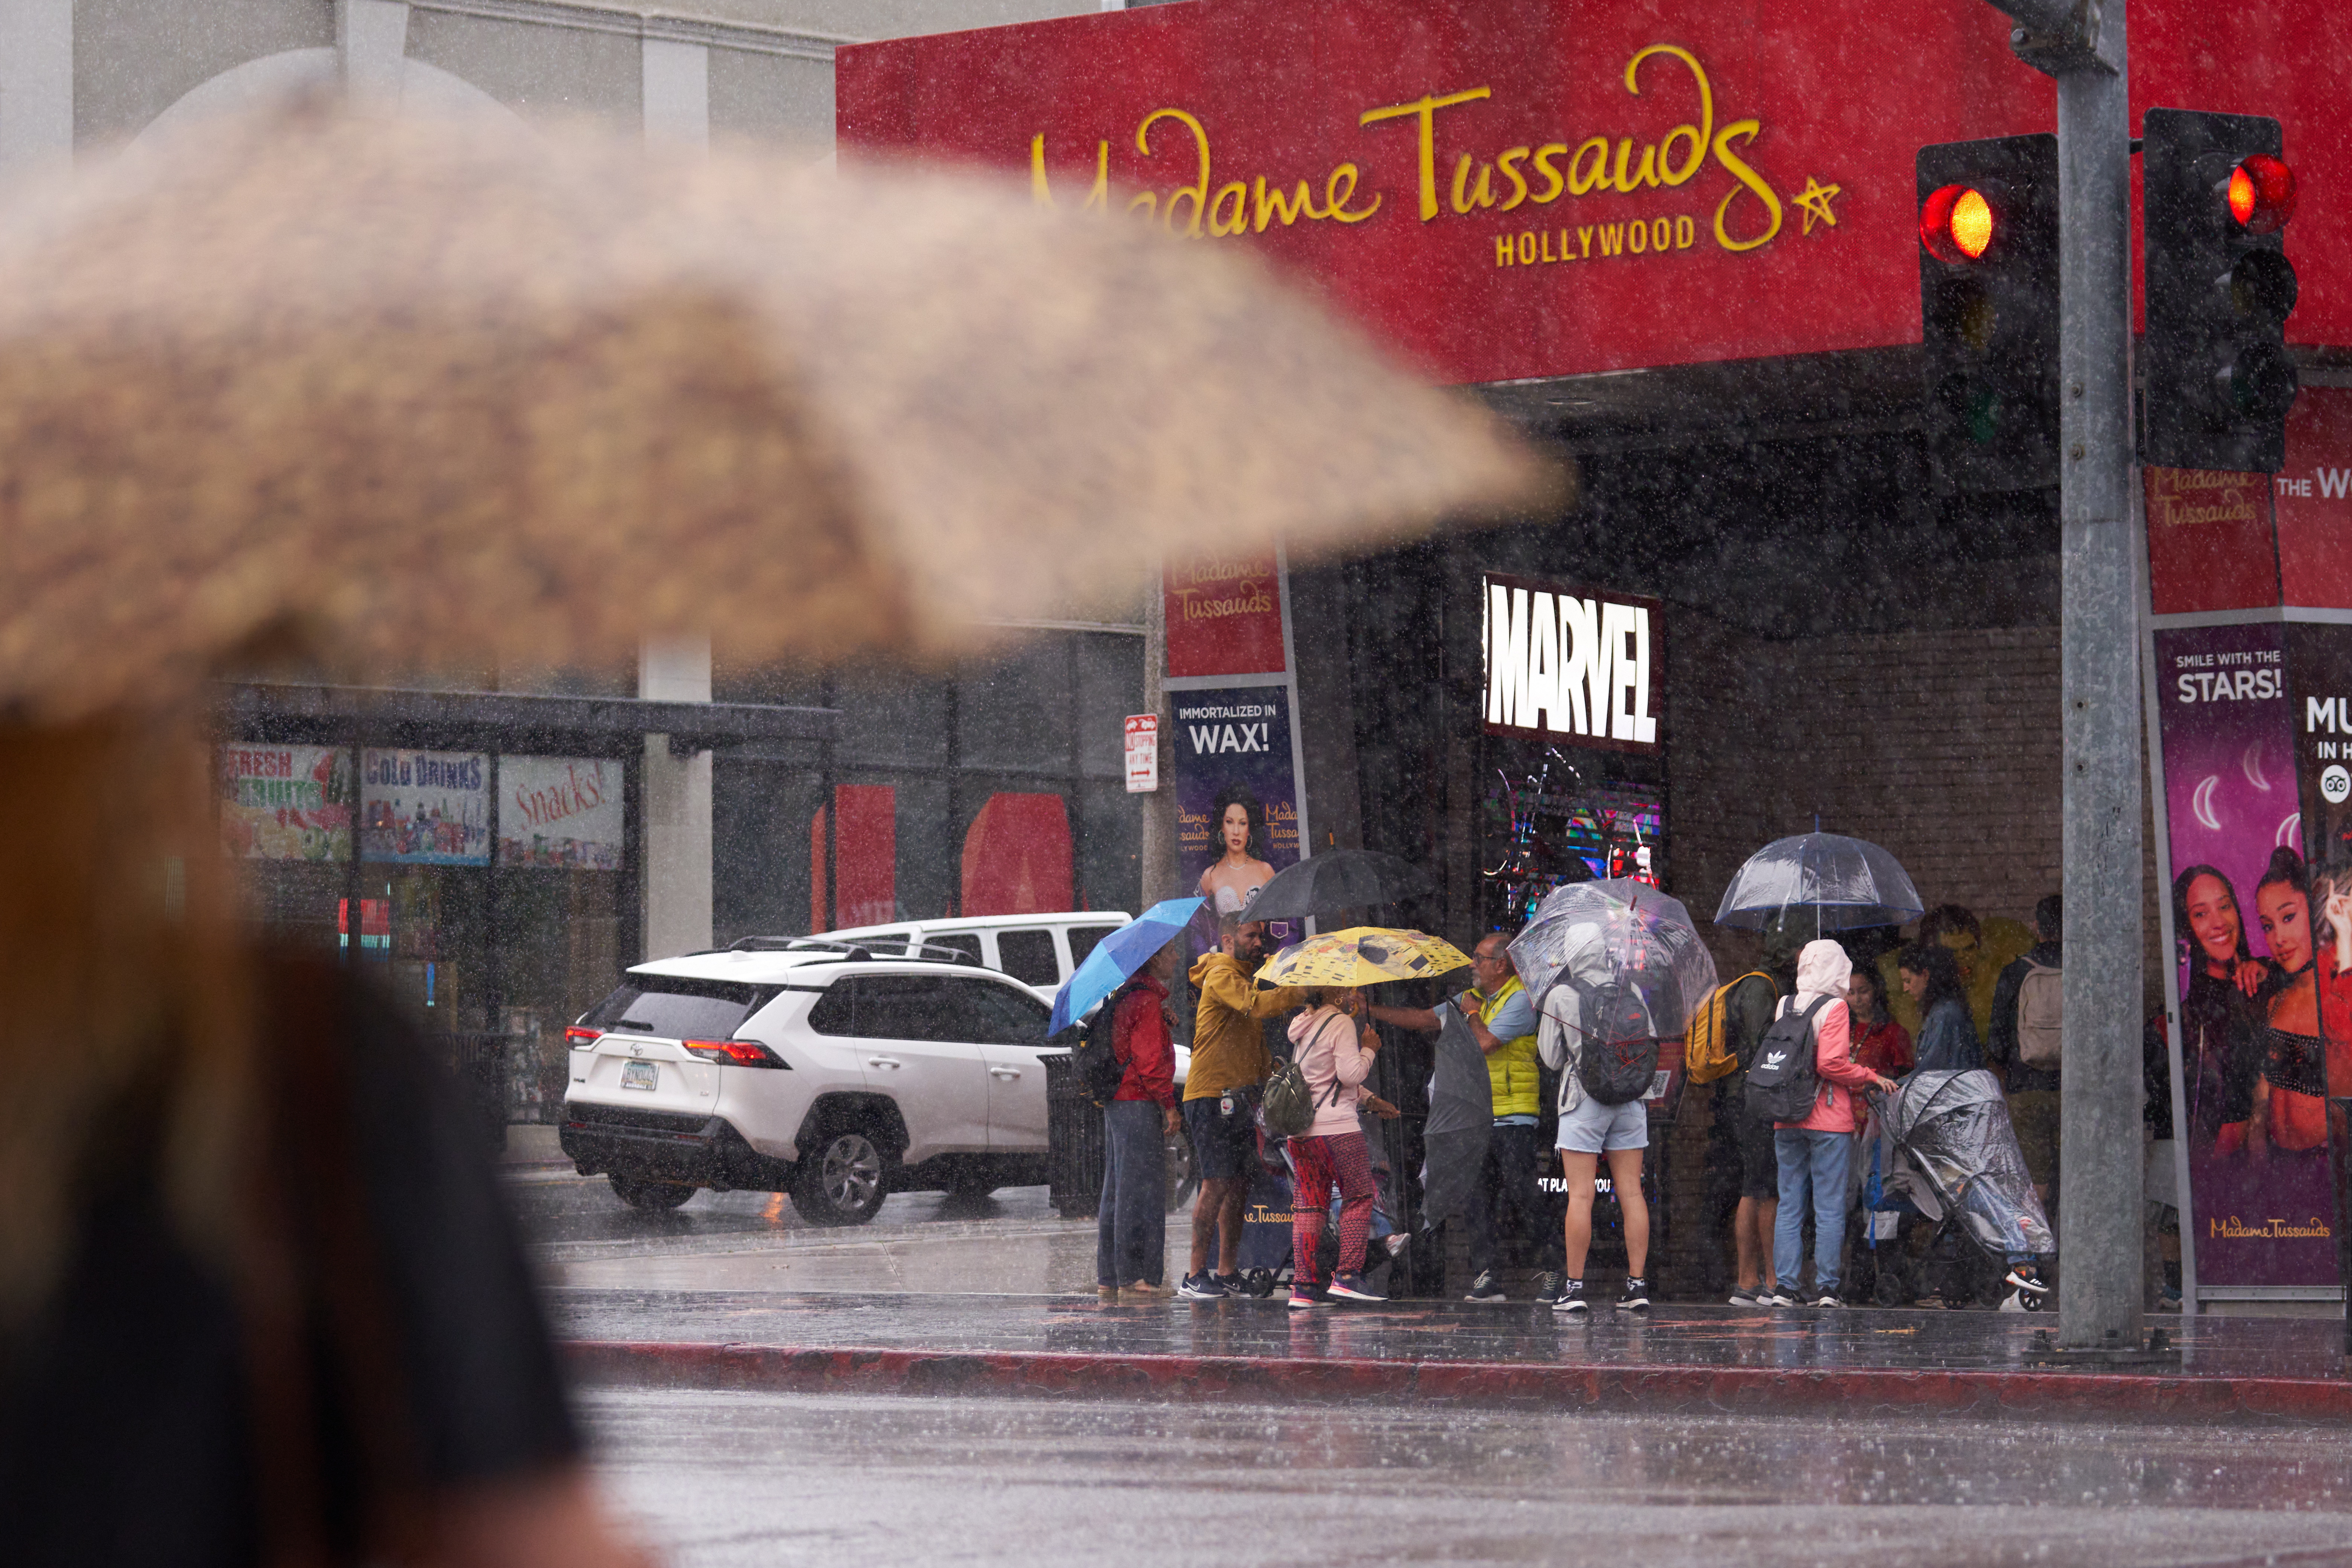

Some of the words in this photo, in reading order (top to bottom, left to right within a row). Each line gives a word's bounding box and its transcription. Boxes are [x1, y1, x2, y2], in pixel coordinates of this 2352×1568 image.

[1359, 43, 1783, 252] Tussauds
[1496, 215, 1695, 267] HOLLYWOOD
[2154, 466, 2257, 493] Madame
[2277, 477, 2312, 497] THE
[2317, 467, 2352, 499] W
[2154, 489, 2256, 526] Tussauds
[1171, 580, 1272, 621] Tussauds
[1489, 584, 1656, 743] MARVEL
[2176, 654, 2214, 668] SMILE
[2217, 652, 2252, 665] WITH
[2255, 650, 2281, 663] THE
[2178, 669, 2283, 703] STARS!
[1180, 705, 1262, 719] IMMORTALIZED
[1265, 705, 1276, 716] IN
[1189, 723, 1269, 754] WAX!
[2318, 741, 2336, 759] IN
[227, 750, 292, 777] FRESH
[1140, 753, 1152, 764] TIME
[416, 754, 481, 790] DRINKS
[1178, 804, 1210, 823] dame
[1265, 801, 1298, 822] Mada
[1180, 823, 1210, 841] sauds
[1265, 822, 1299, 839] Tussa
[1550, 1178, 1568, 1192] PLA
[1252, 1204, 1294, 1223] Tussau
[2210, 1215, 2273, 1238] Madame
[2268, 1216, 2331, 1238] Tussauds
